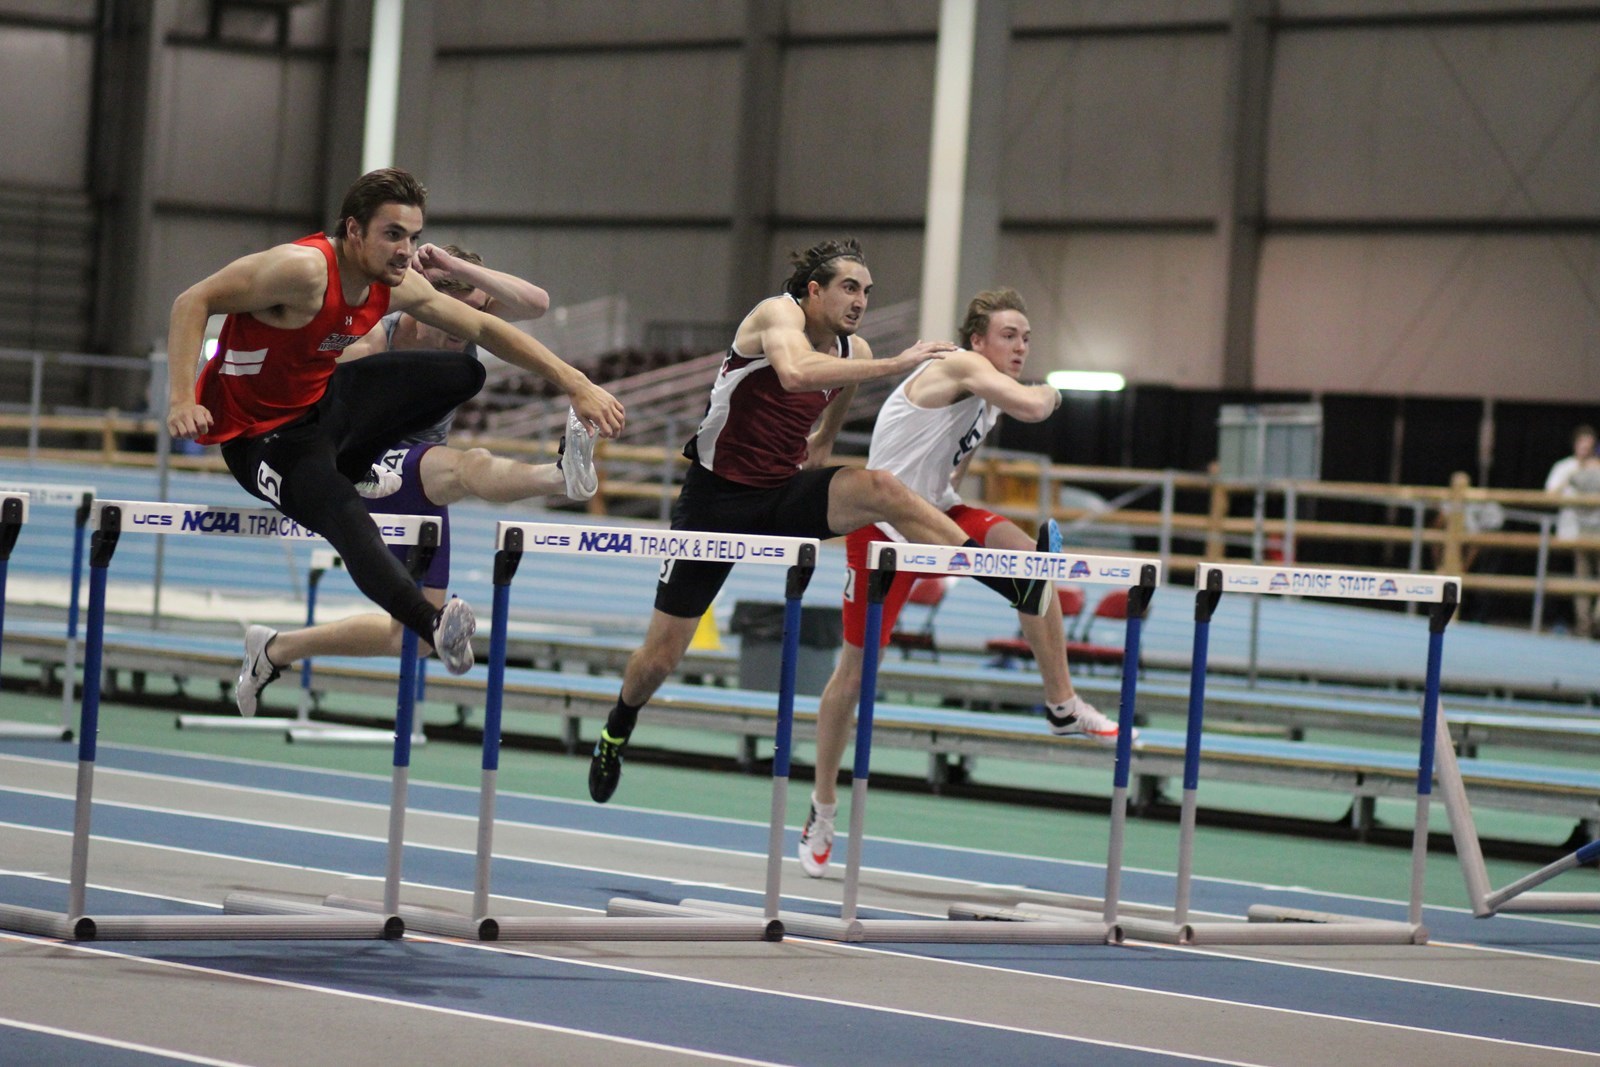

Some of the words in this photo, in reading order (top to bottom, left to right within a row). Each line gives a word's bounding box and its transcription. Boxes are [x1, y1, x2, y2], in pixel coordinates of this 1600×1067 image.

[383, 453, 404, 470] 4
[259, 469, 279, 498] 5
[133, 514, 173, 526] UCS
[181, 510, 240, 534] NCAA
[248, 515, 301, 537] TRACK
[378, 526, 406, 537] CS
[534, 535, 570, 546] UCS
[578, 532, 633, 553] NCAA
[640, 536, 689, 557] TRACK
[693, 539, 703, 558] &
[707, 540, 746, 560] FIELD
[751, 546, 785, 558] UCS
[903, 554, 937, 566] UCS
[974, 553, 1017, 575] BOISE
[1024, 556, 1067, 579] STATE
[1100, 567, 1131, 578] UCS
[1292, 573, 1332, 593] BOISE
[1338, 575, 1376, 596] STATE
